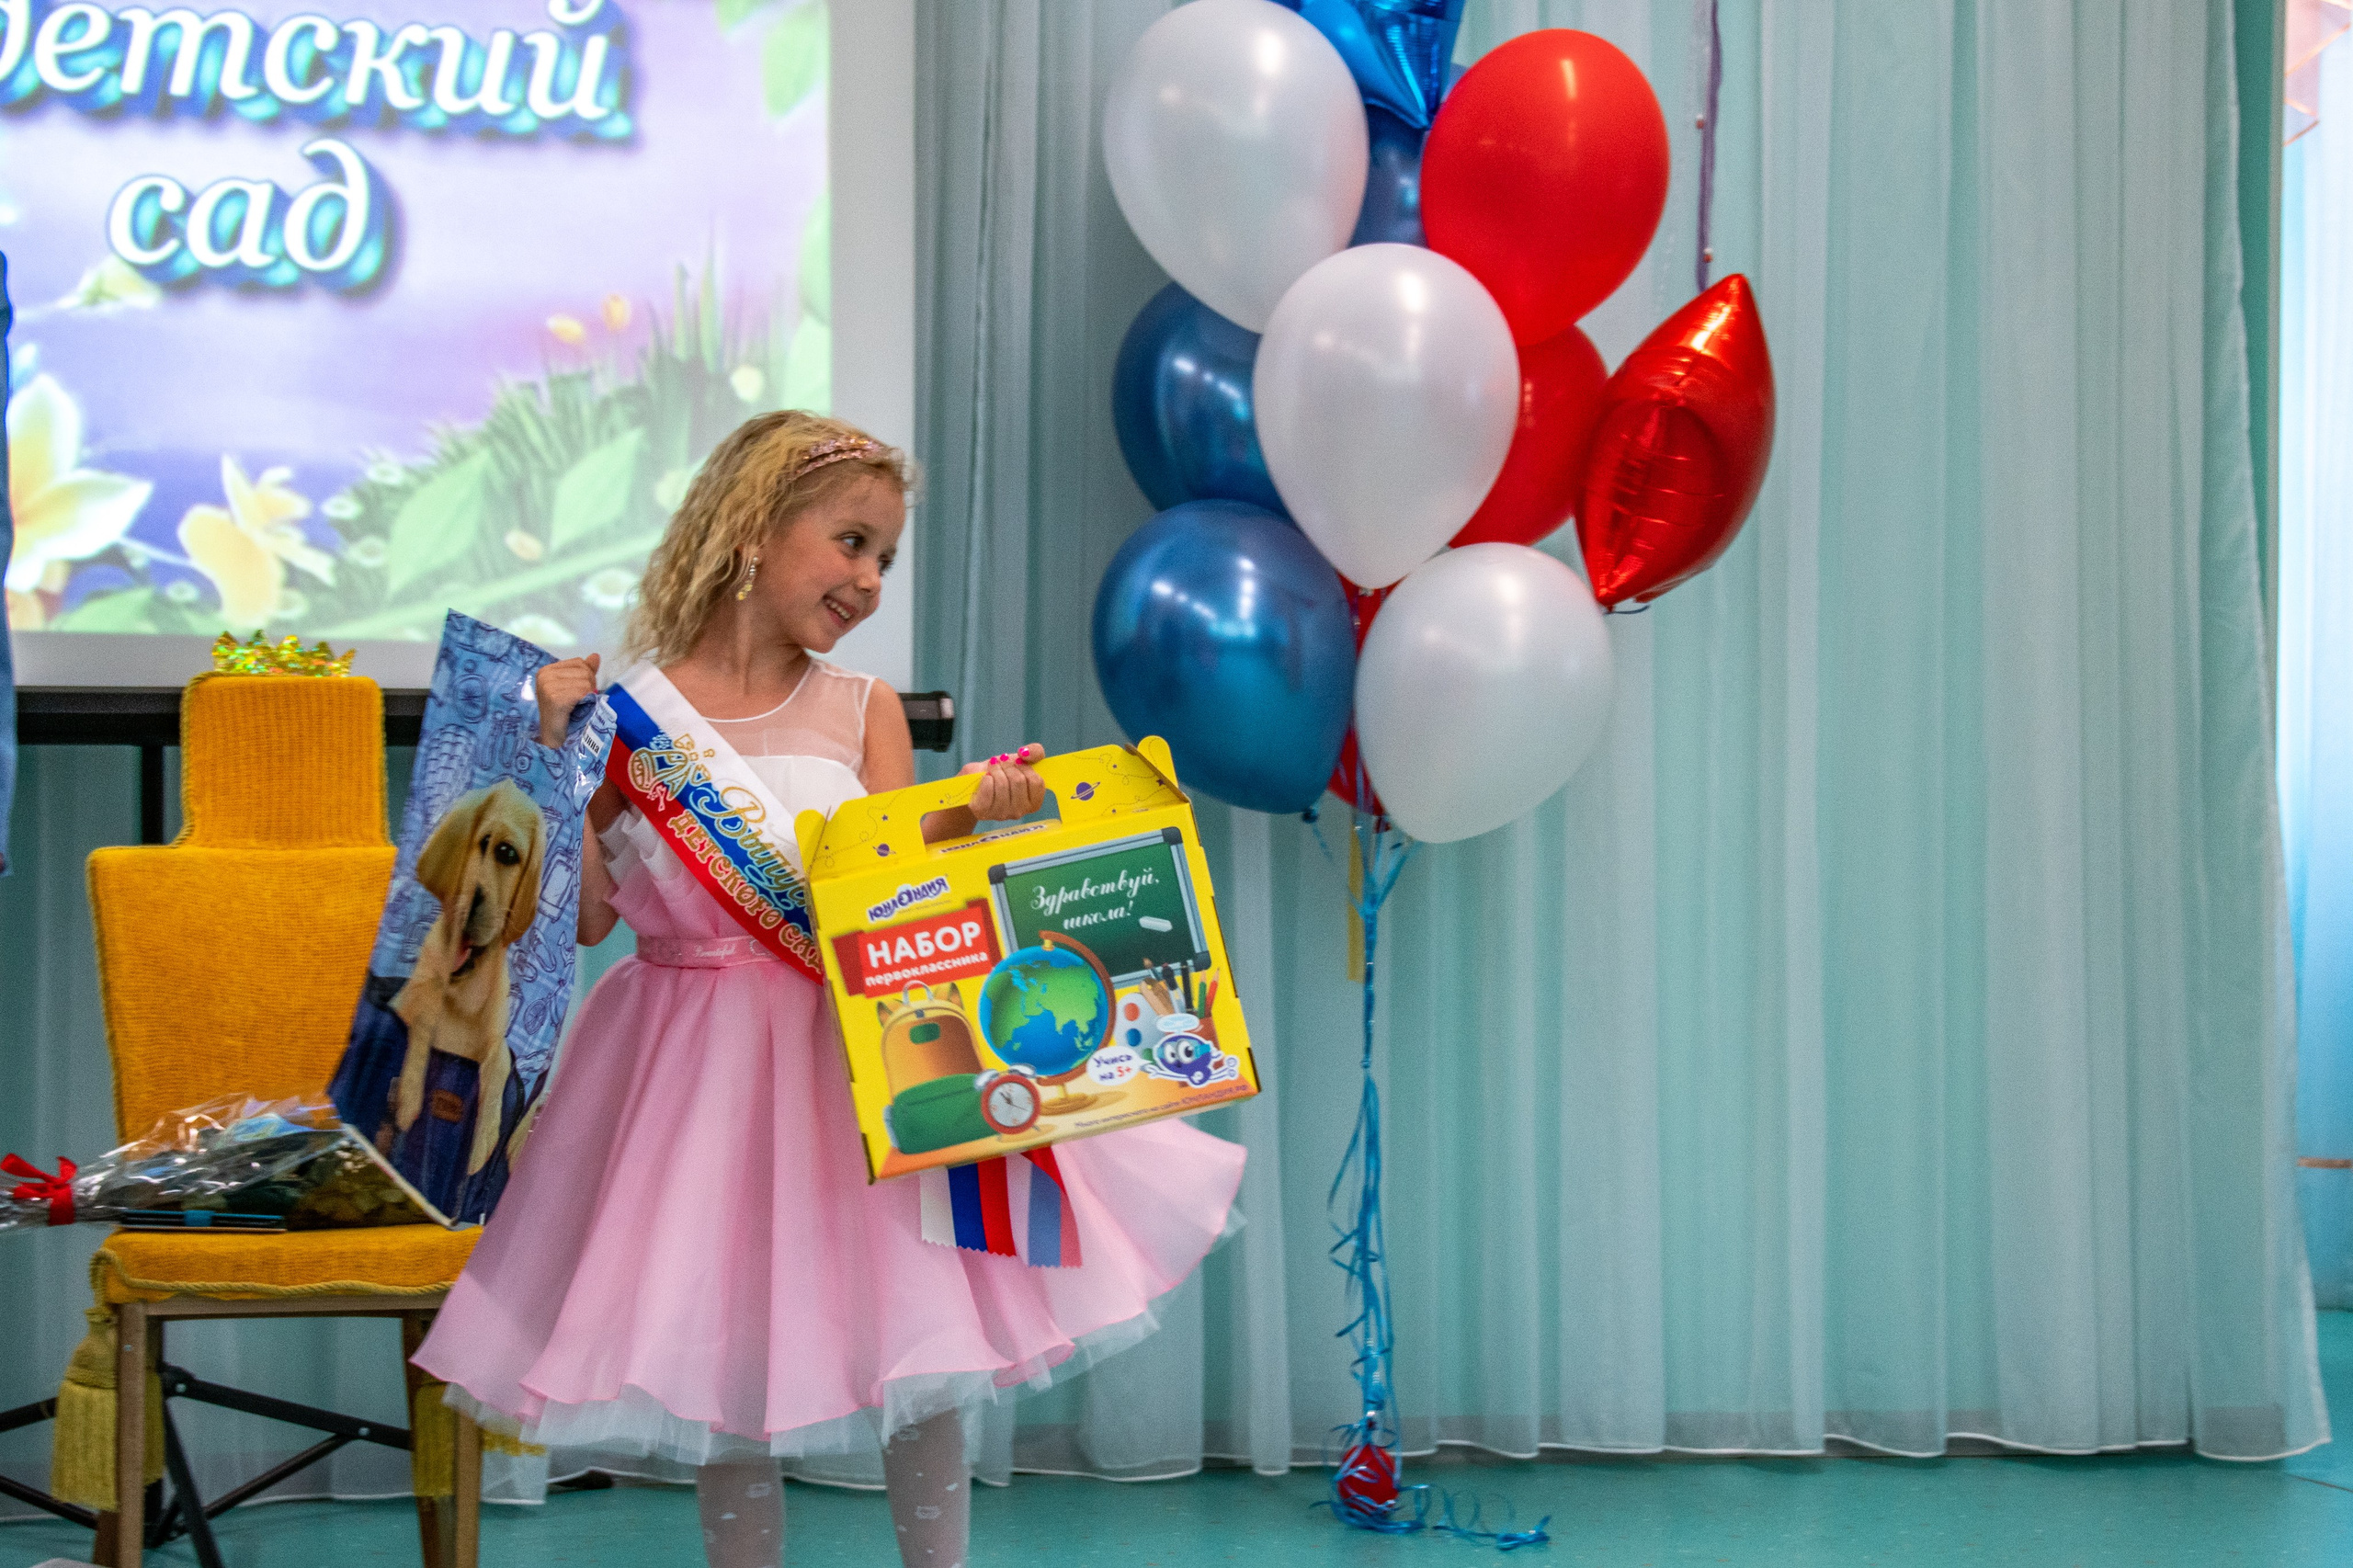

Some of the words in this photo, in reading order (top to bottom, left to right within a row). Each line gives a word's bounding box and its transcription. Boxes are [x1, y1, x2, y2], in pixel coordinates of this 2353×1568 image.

[108, 137, 373, 276] сад
[666, 809, 785, 930] ДЕТСКОГО
[1063, 900, 1134, 930] школа!
[866, 921, 982, 969] НАБОР
[864, 951, 989, 987] первоклассника
[1116, 1065, 1132, 1077] 5+
